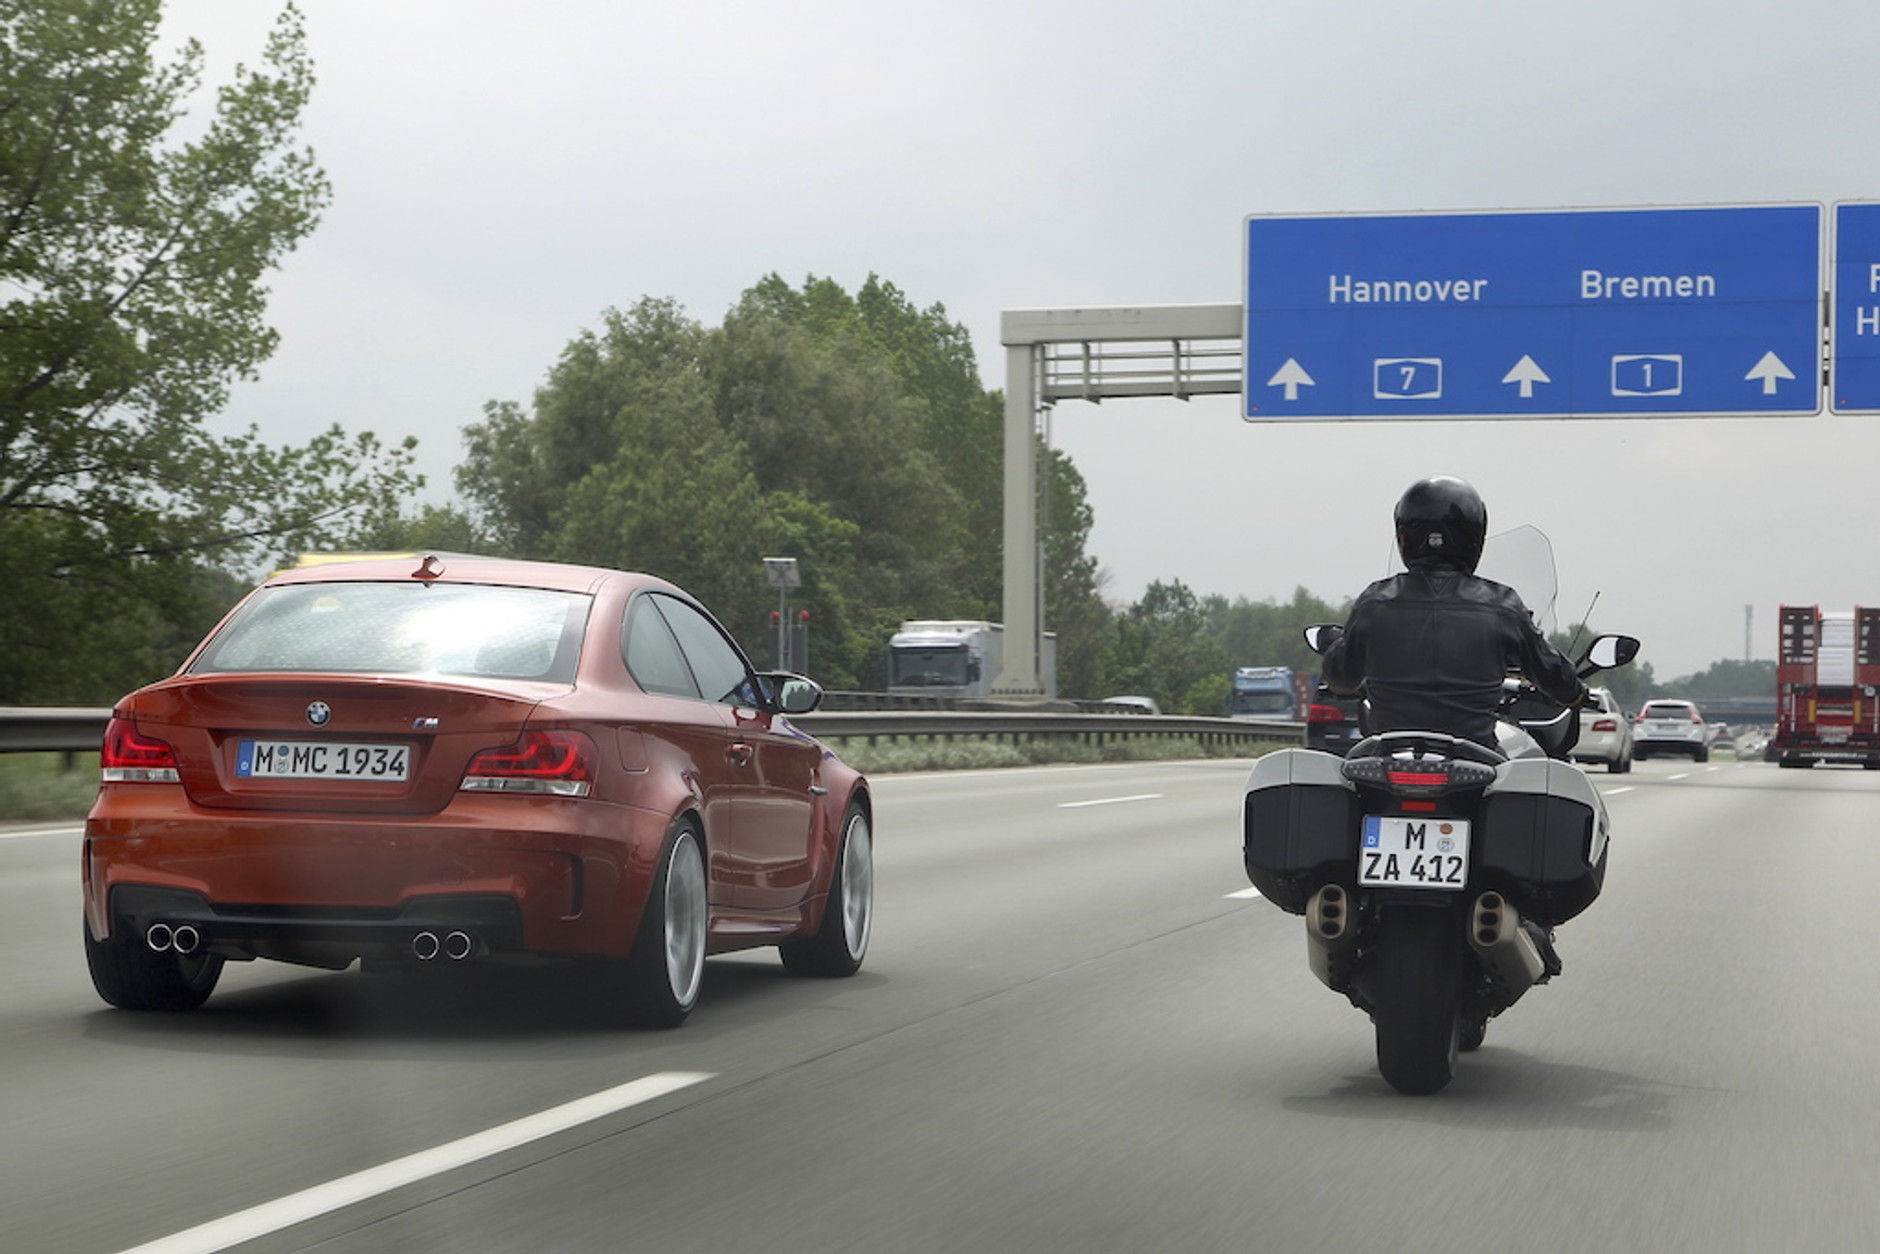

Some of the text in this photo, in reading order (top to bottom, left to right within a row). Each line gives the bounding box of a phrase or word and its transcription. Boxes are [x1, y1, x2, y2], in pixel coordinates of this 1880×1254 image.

[1328, 274, 1488, 304] Hannover
[1580, 269, 1717, 299] Bremen
[1399, 366, 1416, 391] 7
[1641, 363, 1653, 389] 1
[254, 745, 275, 773] M
[292, 746, 328, 774] MC
[334, 748, 406, 777] 1934
[1367, 822, 1427, 851] D M
[1364, 852, 1464, 884] ZA 412
